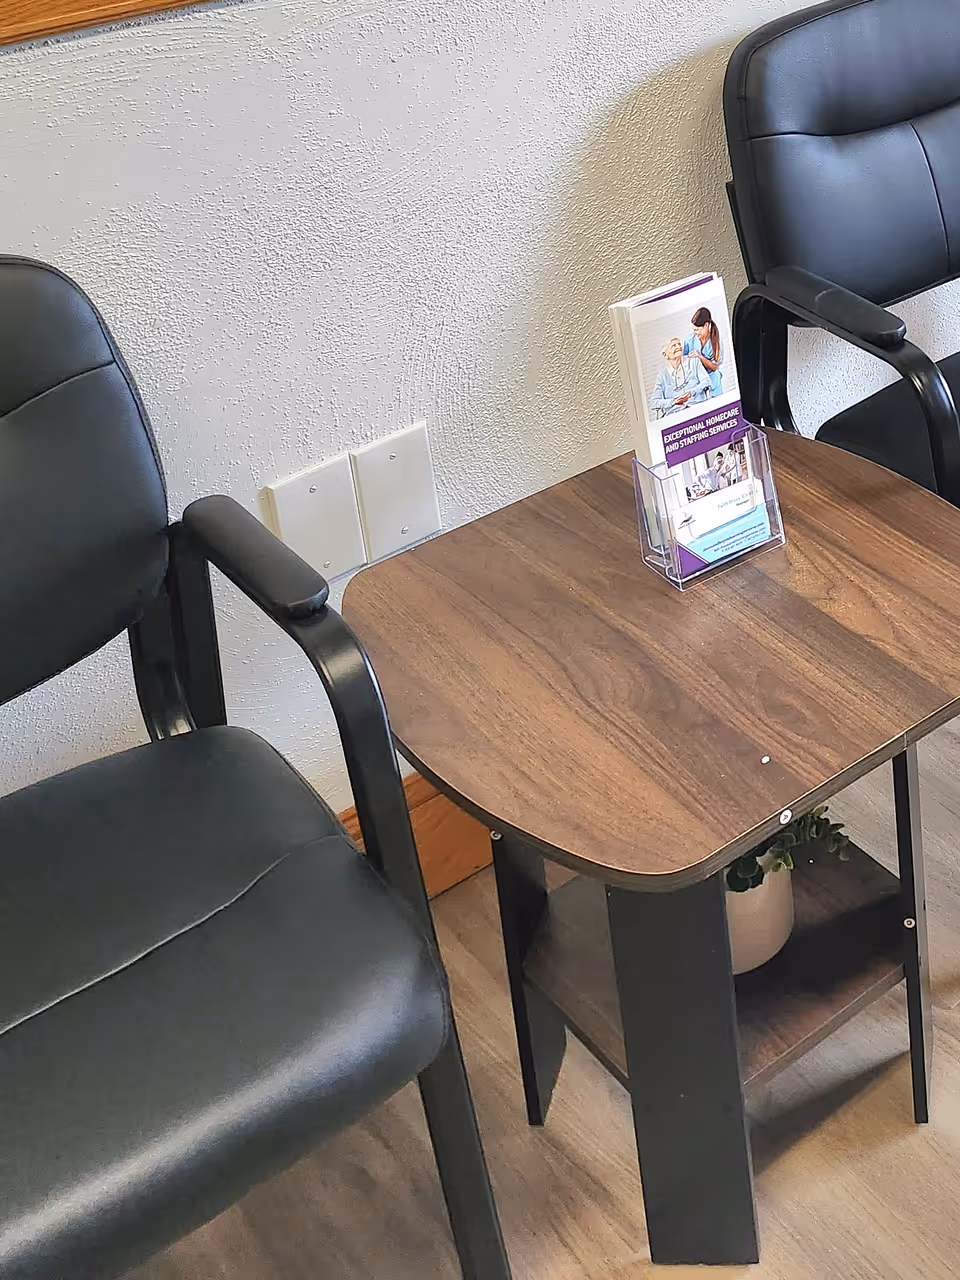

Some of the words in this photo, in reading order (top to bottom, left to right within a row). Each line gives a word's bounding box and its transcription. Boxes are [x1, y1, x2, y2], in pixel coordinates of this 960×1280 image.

[664, 421, 706, 444] EXCEPTIONAL
[705, 407, 740, 427] HOMECARE
[665, 442, 680, 454] AND
[679, 429, 709, 448] STAFFING
[709, 418, 738, 436] SERVICES
